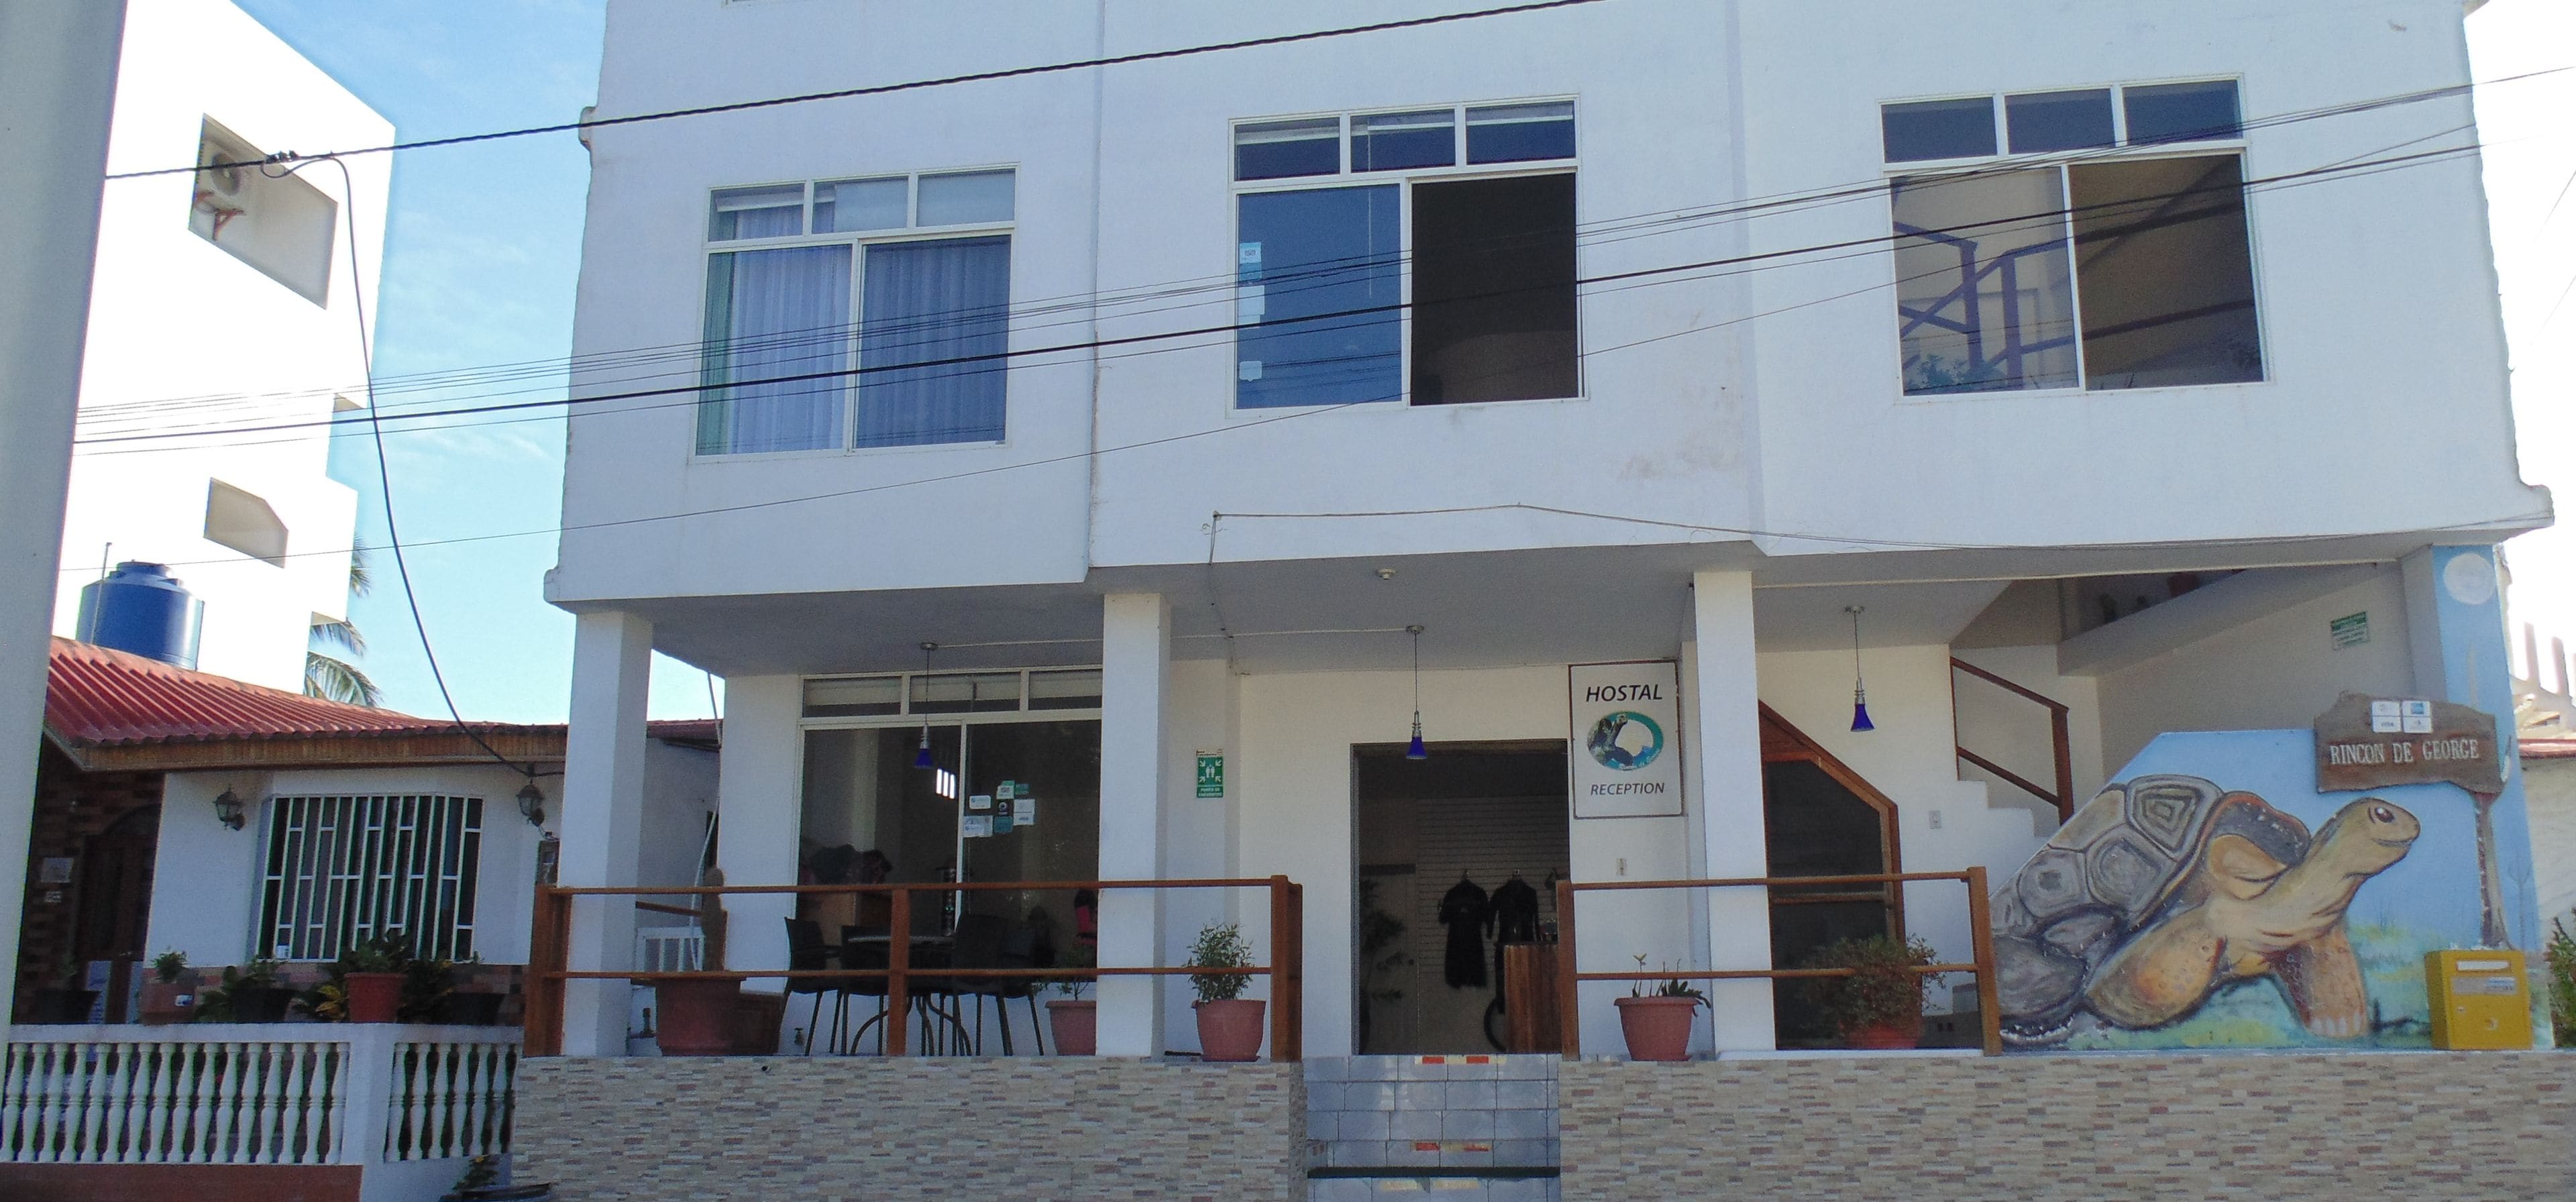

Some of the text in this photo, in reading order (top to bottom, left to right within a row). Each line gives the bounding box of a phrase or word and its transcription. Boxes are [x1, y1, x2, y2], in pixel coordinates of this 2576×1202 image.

[1586, 684, 1662, 702] HOSTAL
[2330, 739, 2479, 765] RINCON DE GEORGE
[1591, 783, 1665, 796] RECEPTION
